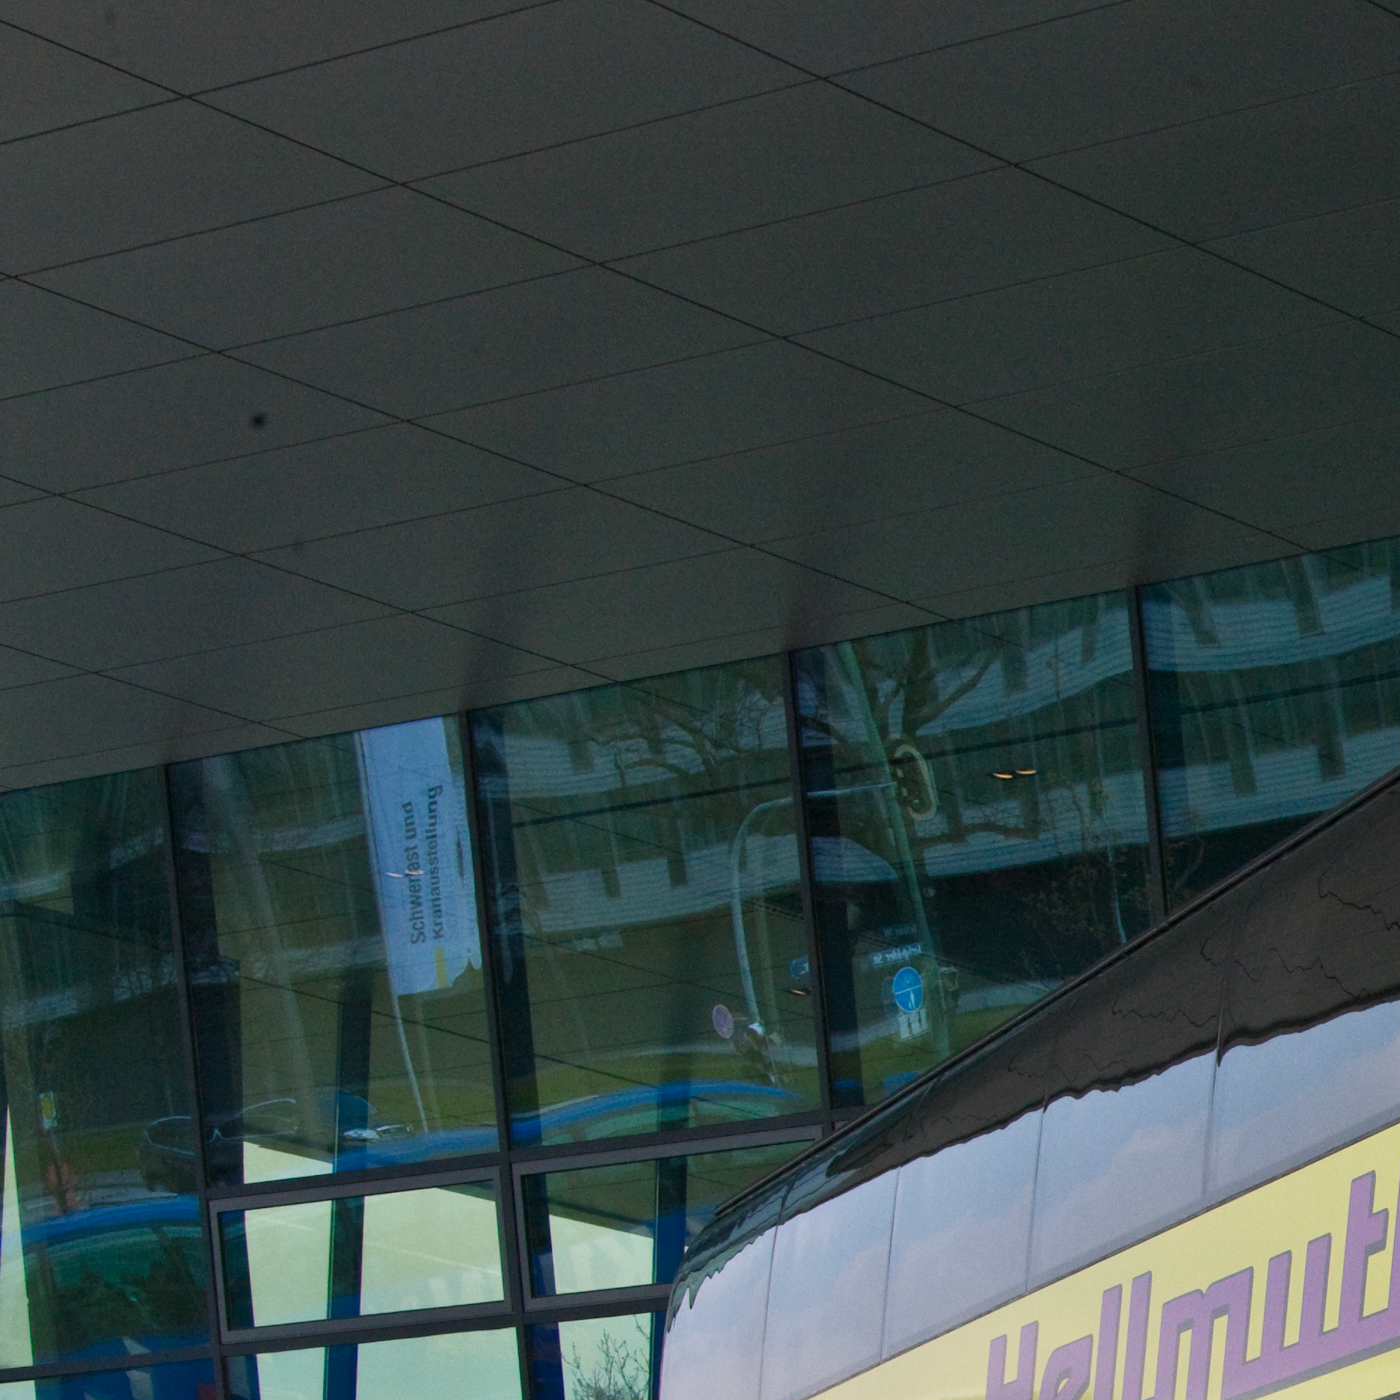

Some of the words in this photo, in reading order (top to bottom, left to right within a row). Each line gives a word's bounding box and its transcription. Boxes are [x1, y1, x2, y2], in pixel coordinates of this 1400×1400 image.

[401, 801, 418, 839] und
[425, 784, 443, 940] Kranausstellung
[404, 844, 426, 945] Schwerlast
